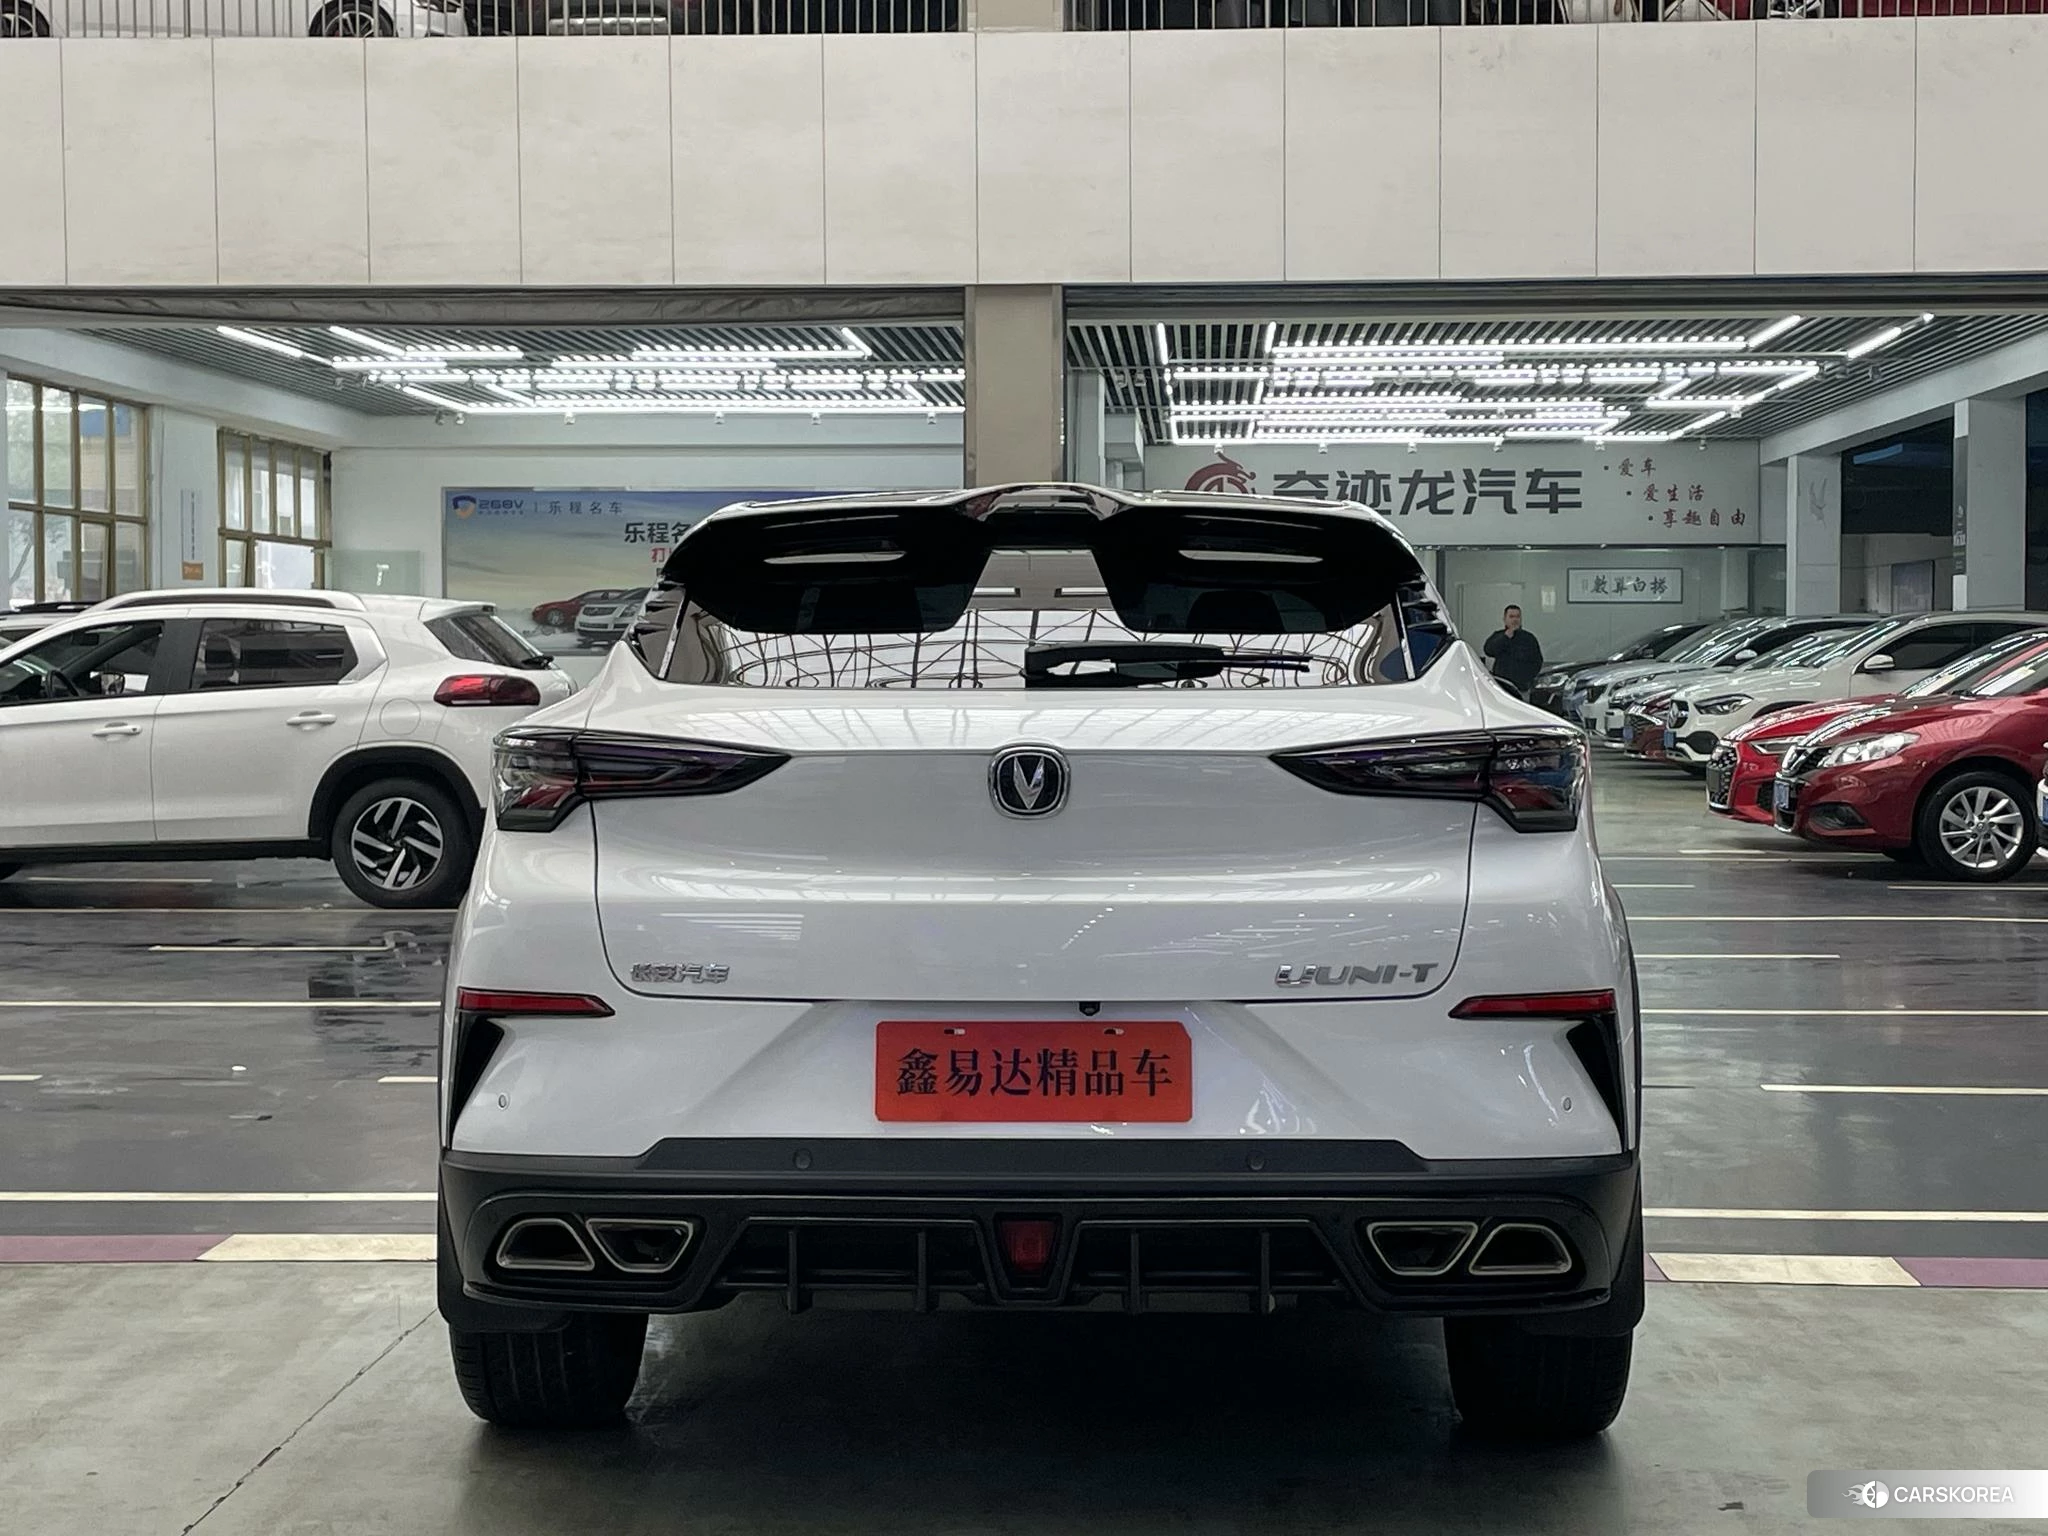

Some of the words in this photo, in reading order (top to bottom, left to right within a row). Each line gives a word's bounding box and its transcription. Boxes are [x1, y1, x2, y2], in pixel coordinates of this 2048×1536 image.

[549, 501, 623, 515] 乐程名车
[1273, 468, 1582, 515] 奇迹龙汽车
[1663, 508, 1746, 528] 享趣自由
[896, 1047, 1173, 1097] 鑫易达精品车
